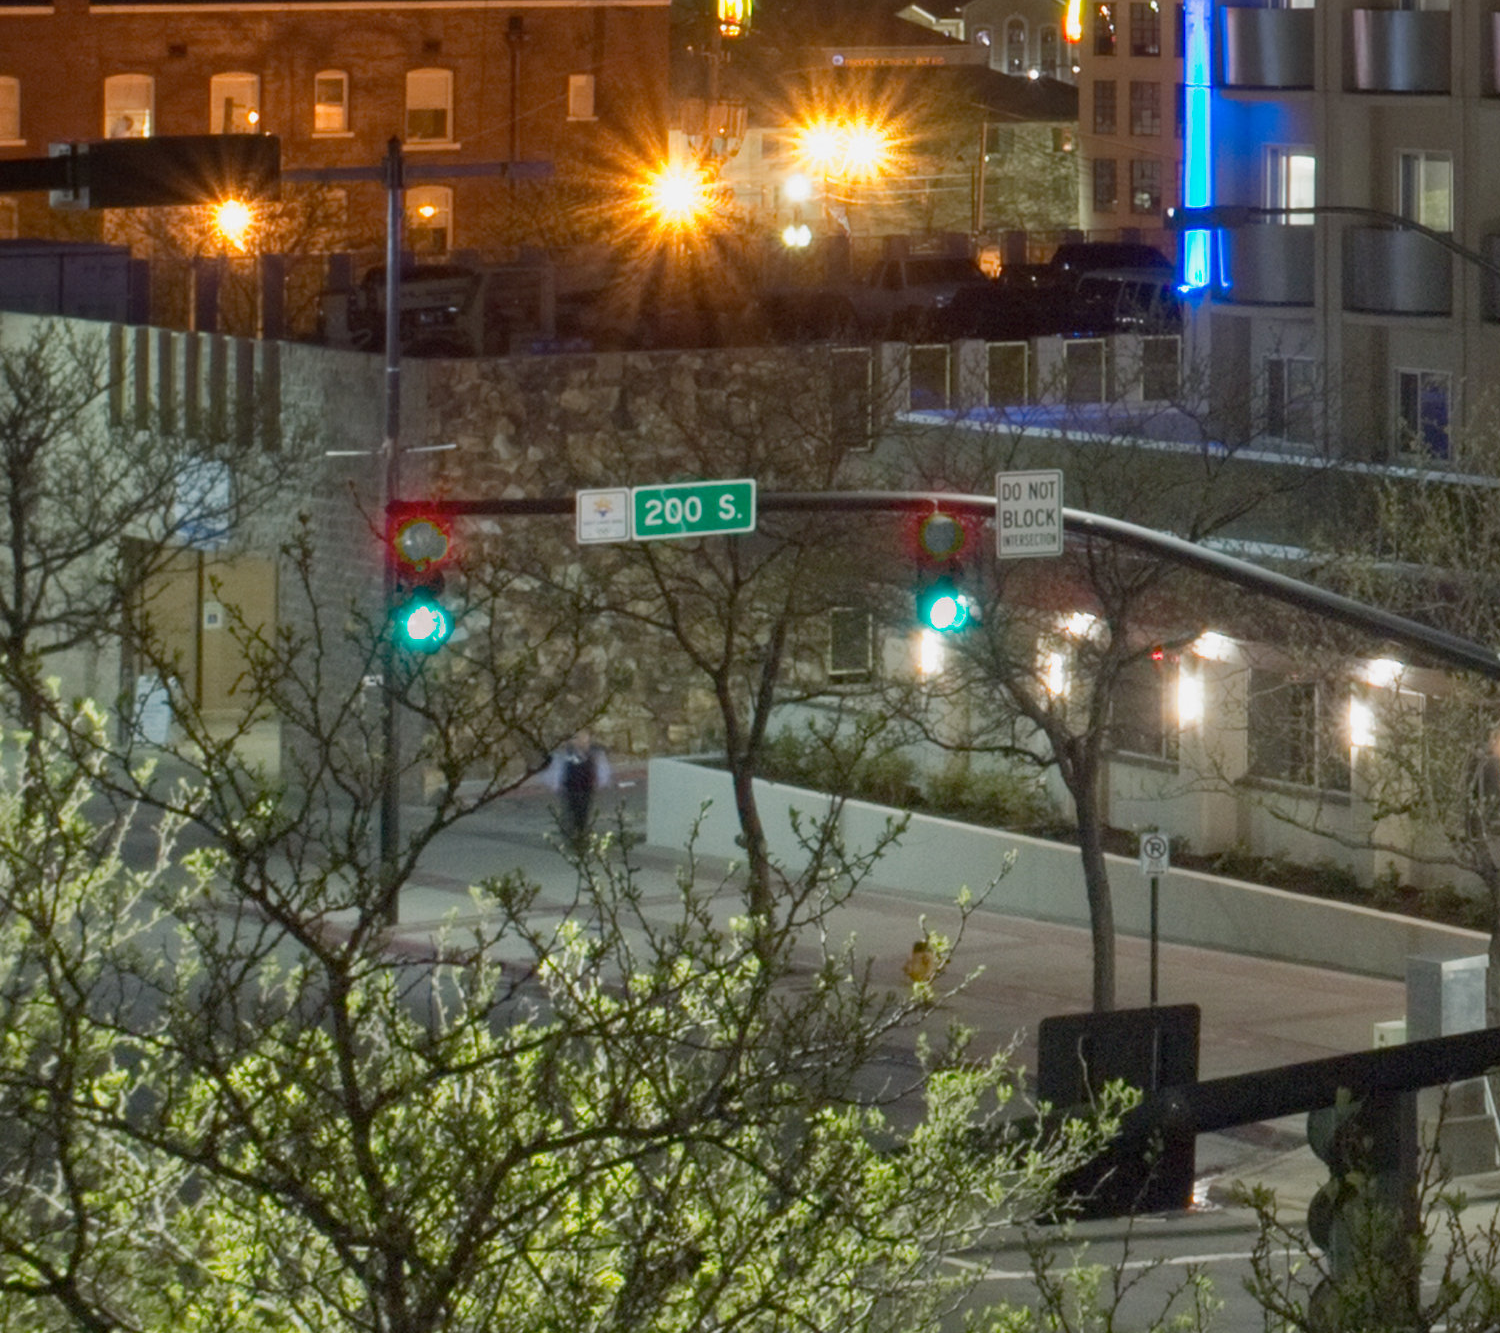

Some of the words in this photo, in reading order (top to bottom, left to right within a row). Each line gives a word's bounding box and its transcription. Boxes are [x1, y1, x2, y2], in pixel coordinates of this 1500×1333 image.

[1002, 482, 1022, 502] DO
[1028, 480, 1056, 500] NOT
[644, 496, 702, 527] 200
[718, 493, 743, 521] S.
[1002, 508, 1056, 529] BLOCK
[1002, 532, 1057, 548] INTERSECTION
